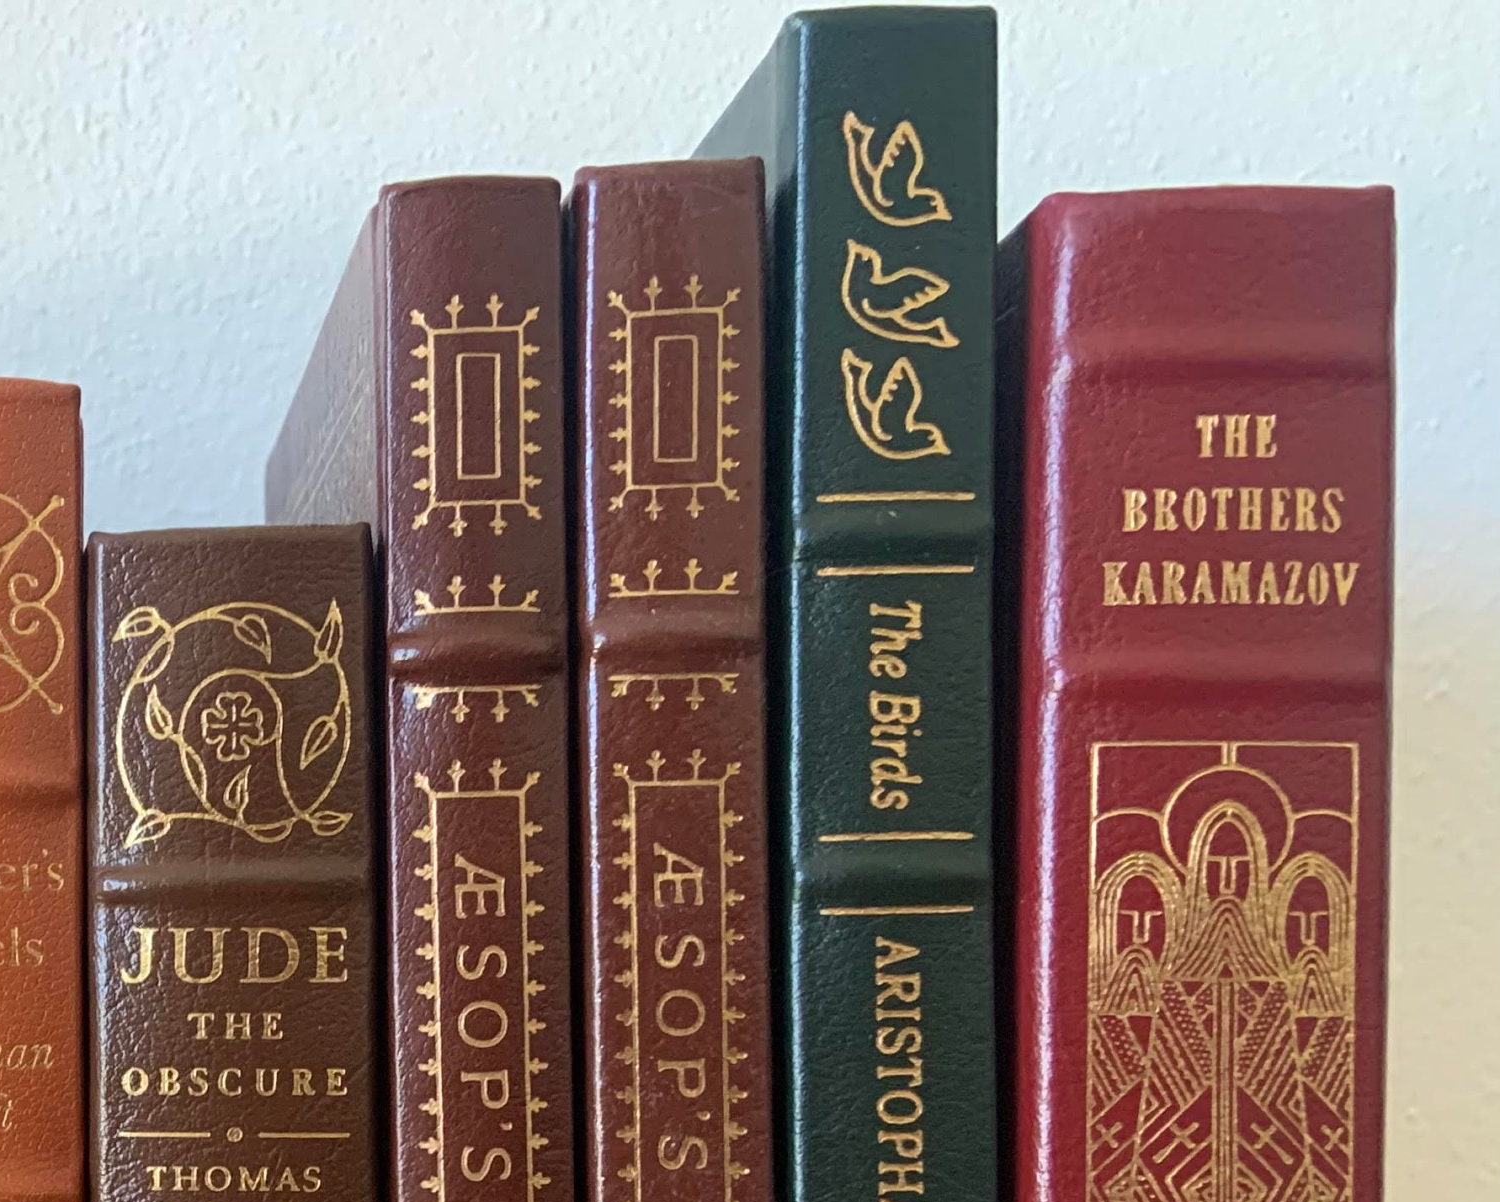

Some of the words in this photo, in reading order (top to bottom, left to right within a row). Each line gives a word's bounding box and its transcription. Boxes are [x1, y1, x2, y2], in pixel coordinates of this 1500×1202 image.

[1196, 414, 1278, 458] THE
[1122, 487, 1345, 533] BROTHERS
[1101, 560, 1361, 607] KARAMAZOV
[869, 600, 924, 679] The
[869, 690, 924, 810] Birds
[120, 926, 348, 984] JUDE
[187, 1012, 284, 1041] THE
[120, 1067, 348, 1097] OBSCURE
[146, 1165, 322, 1193] THOMAS
